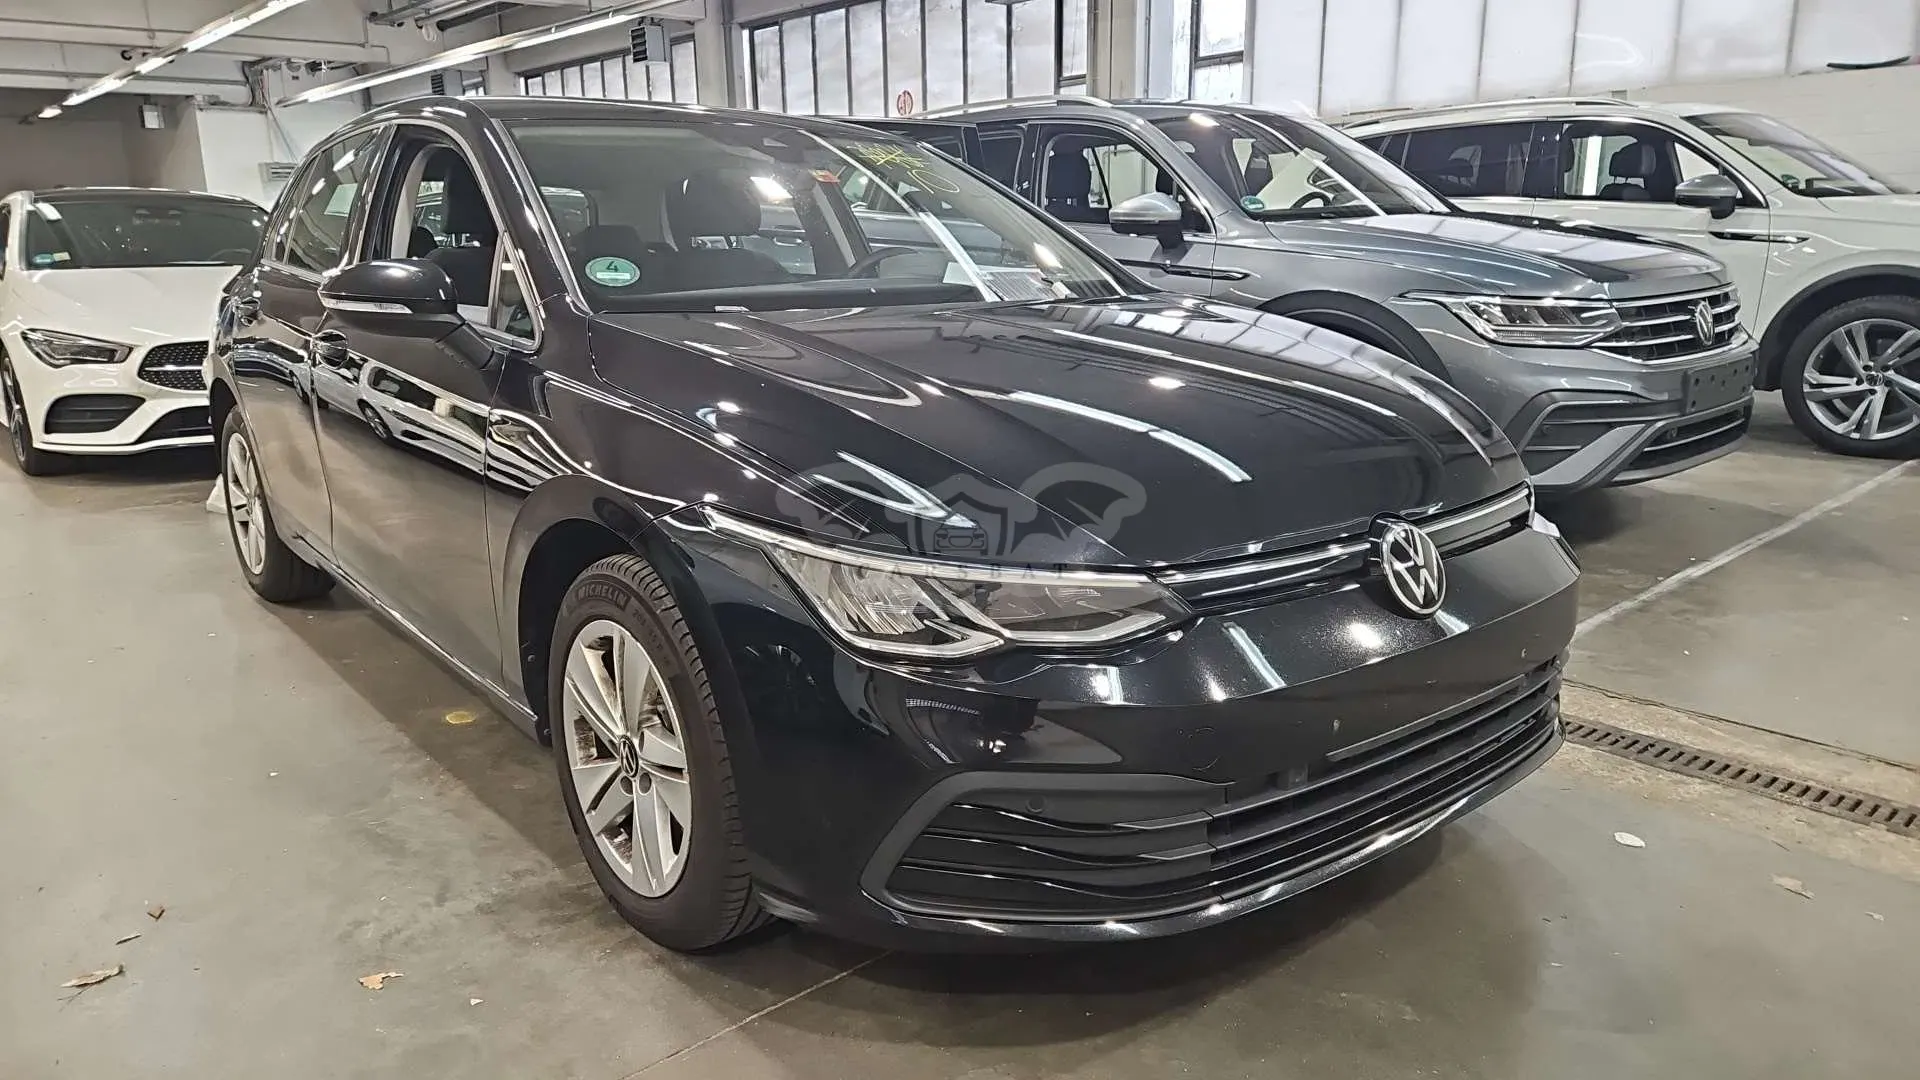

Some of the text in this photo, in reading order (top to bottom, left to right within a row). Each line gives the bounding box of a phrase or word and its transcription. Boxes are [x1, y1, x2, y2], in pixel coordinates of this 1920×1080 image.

[606, 261, 619, 272] 4
[1381, 522, 1446, 614] VW
[578, 583, 629, 610] MICHELIN
